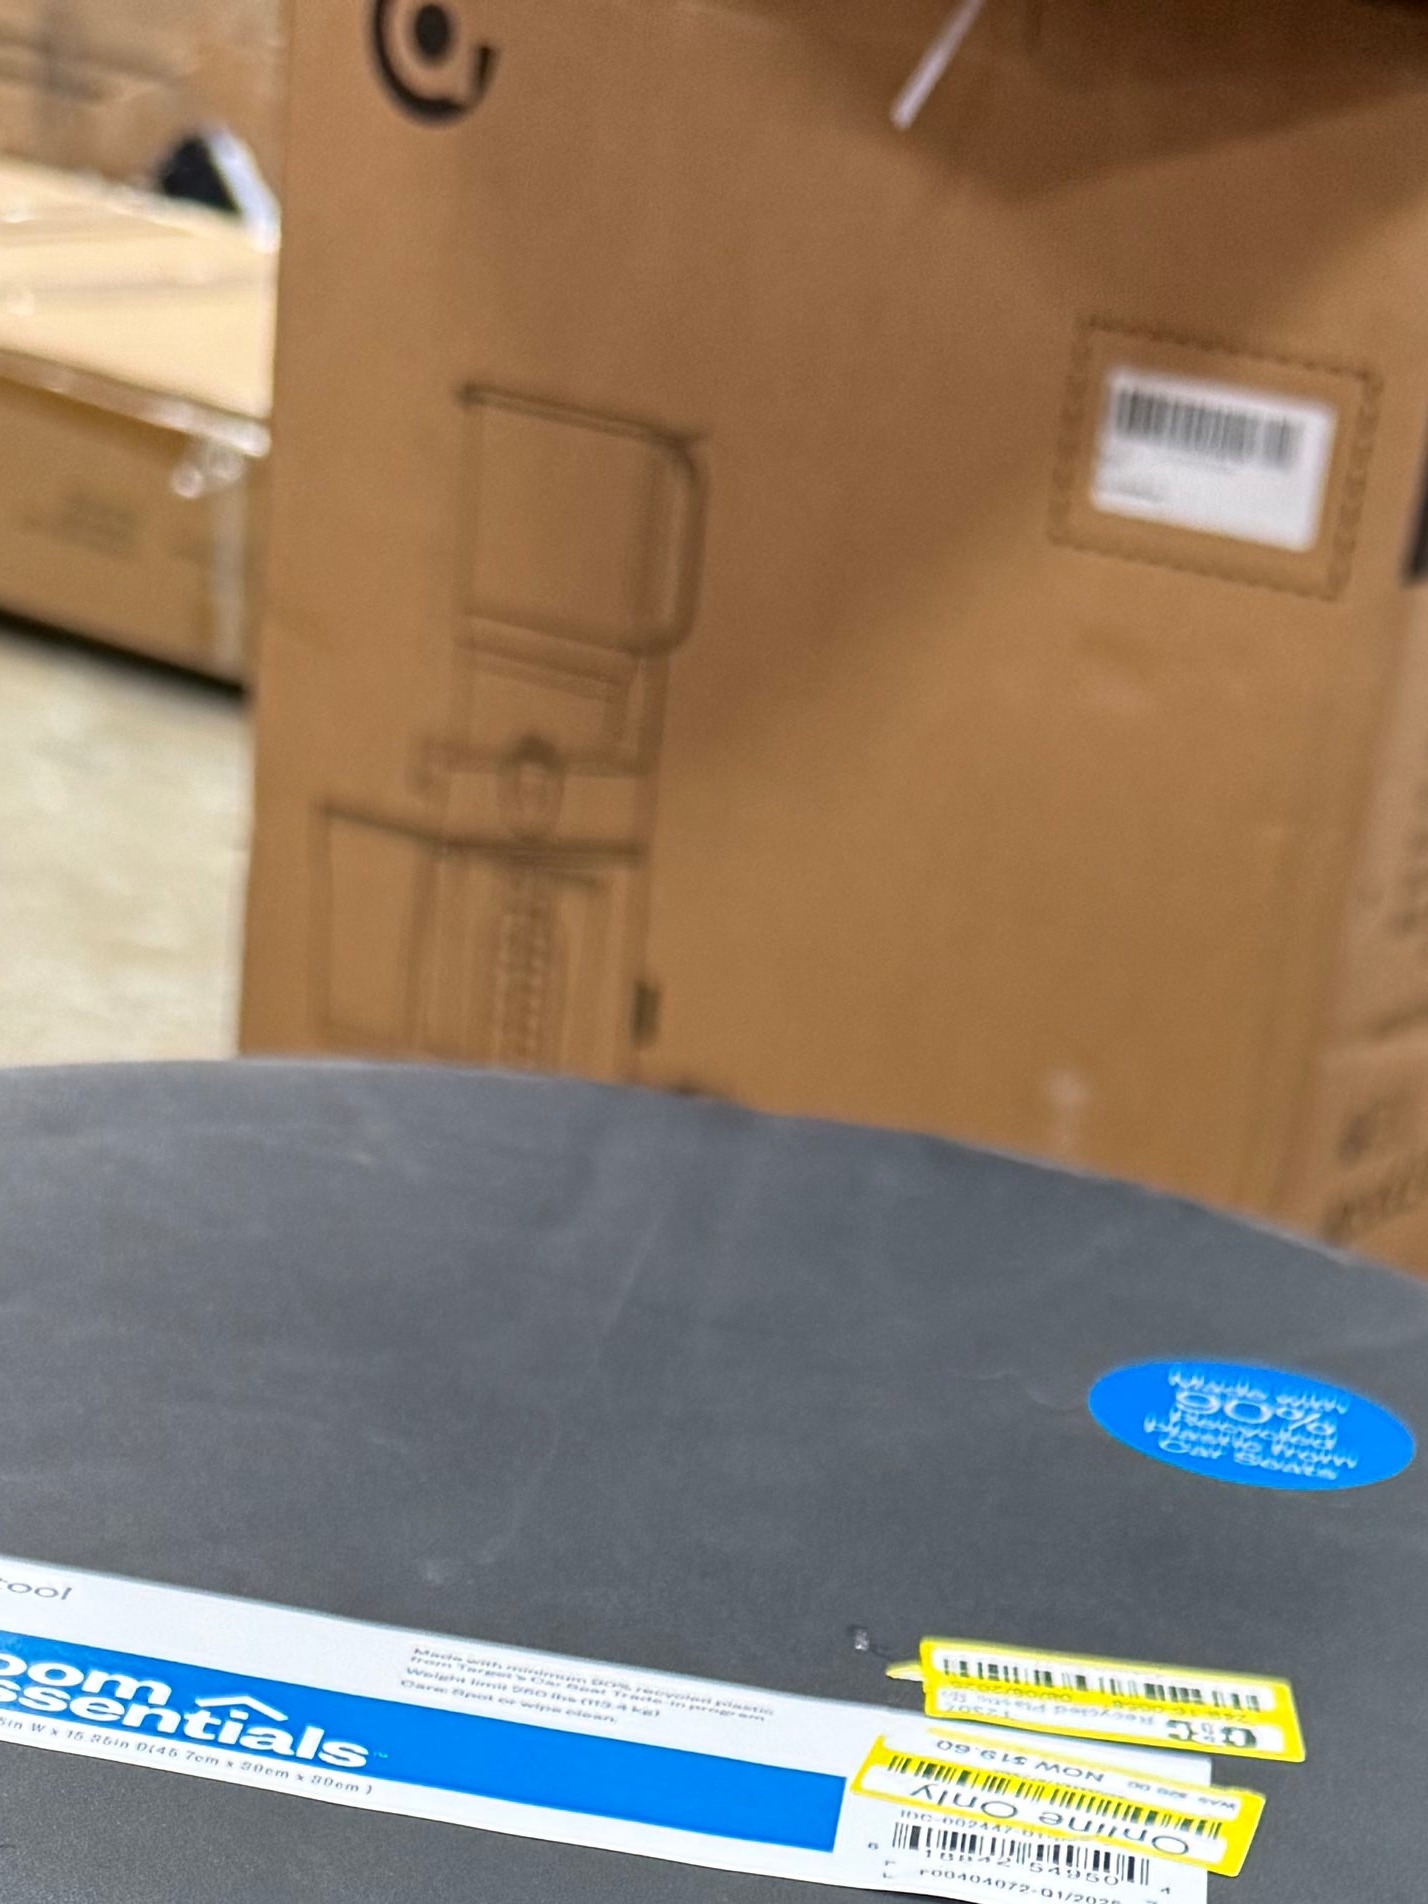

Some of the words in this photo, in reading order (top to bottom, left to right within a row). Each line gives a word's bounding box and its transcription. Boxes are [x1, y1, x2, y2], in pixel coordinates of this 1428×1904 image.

[1144, 1413, 1262, 1451] Plastic
[1170, 1409, 1337, 1450] Recycled
[1175, 1391, 1336, 1436] 90%
[1158, 1439, 1222, 1459] Car
[1234, 1449, 1337, 1480] Seats
[406, 1667, 466, 1684] Weight
[471, 1678, 508, 1691] limit
[414, 1648, 463, 1663] Made
[466, 1658, 503, 1670] with
[507, 1665, 587, 1684] minimum
[636, 1686, 712, 1706] recycled
[716, 1698, 774, 1716] plastic
[935, 1738, 1029, 1768] $19.60
[1035, 1760, 1106, 1784] NOW
[910, 1782, 1019, 1820] Only
[1038, 1810, 1191, 1856] Online
[1028, 1861, 1120, 1887] 54950
